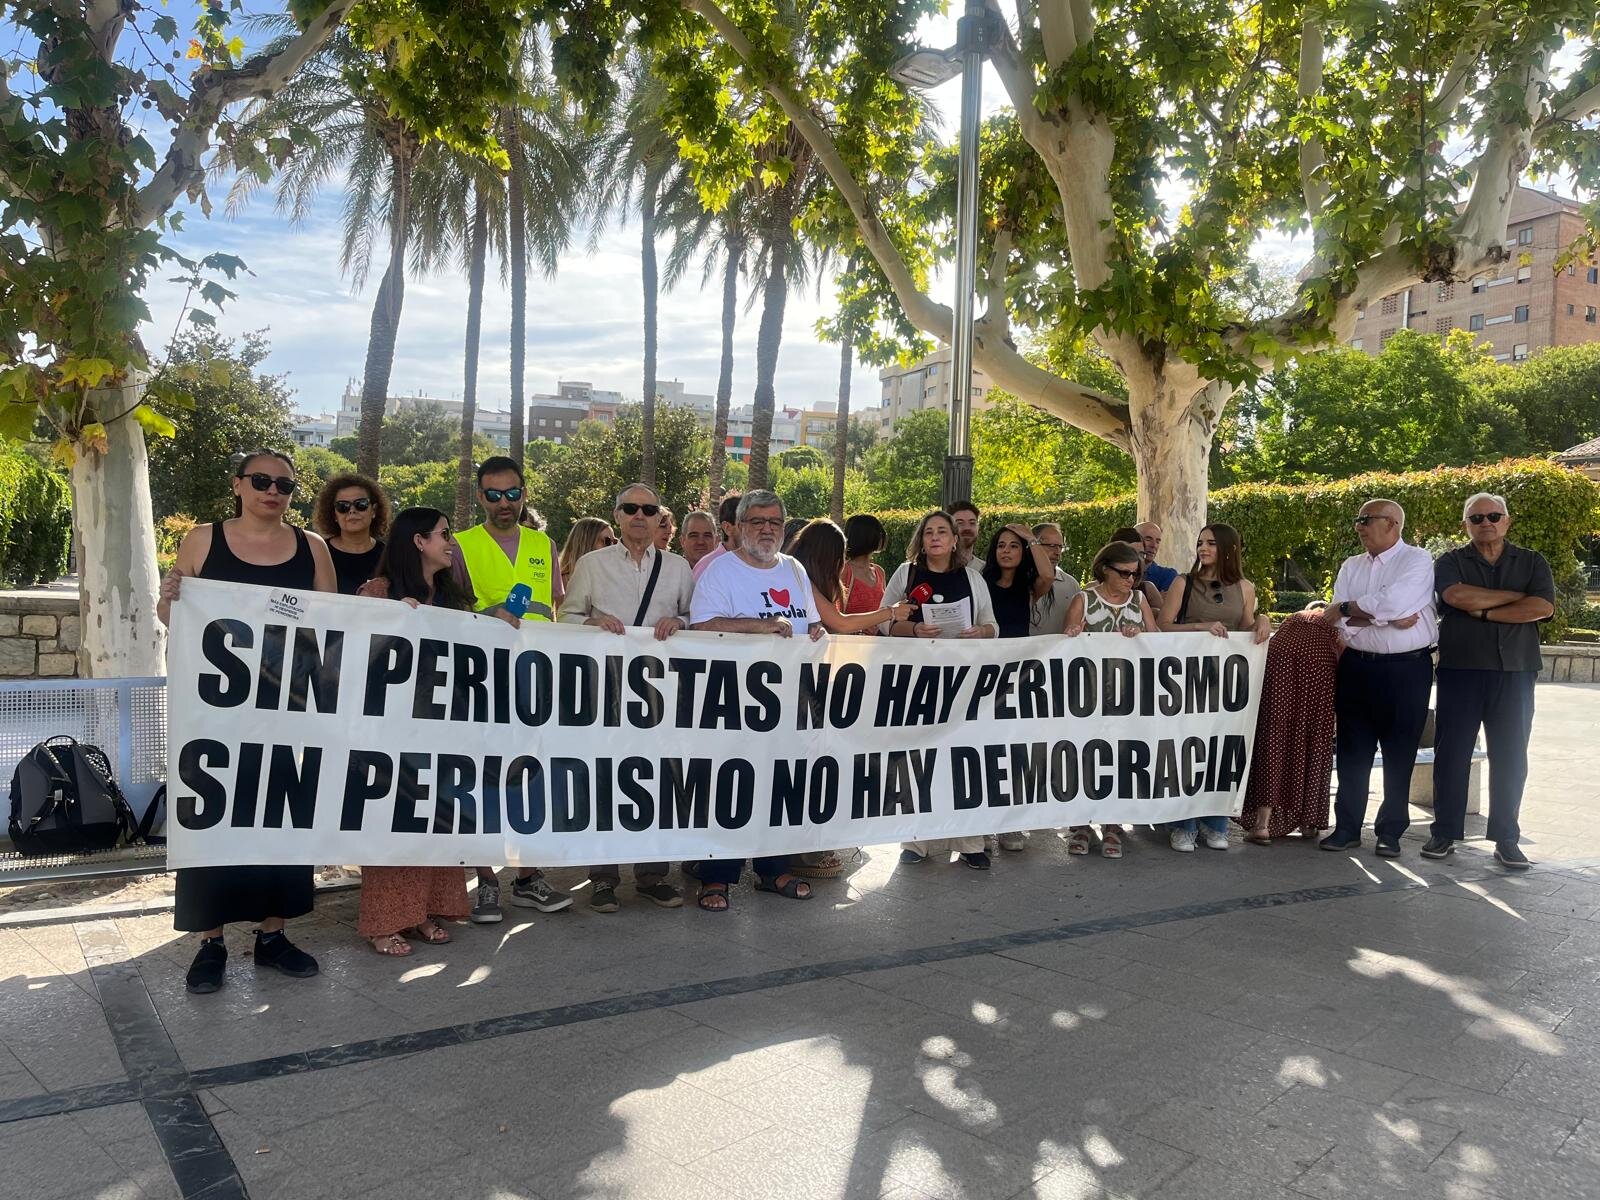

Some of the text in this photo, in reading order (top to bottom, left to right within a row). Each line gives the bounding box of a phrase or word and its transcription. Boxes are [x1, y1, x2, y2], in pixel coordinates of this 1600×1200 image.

[282, 594, 297, 605] NO
[197, 618, 1250, 733] SIN PERIODISTAS NO HAY PERIODISMO
[176, 734, 1247, 835] SIN PERIODISMO NO HAY DEMOCRACIA
